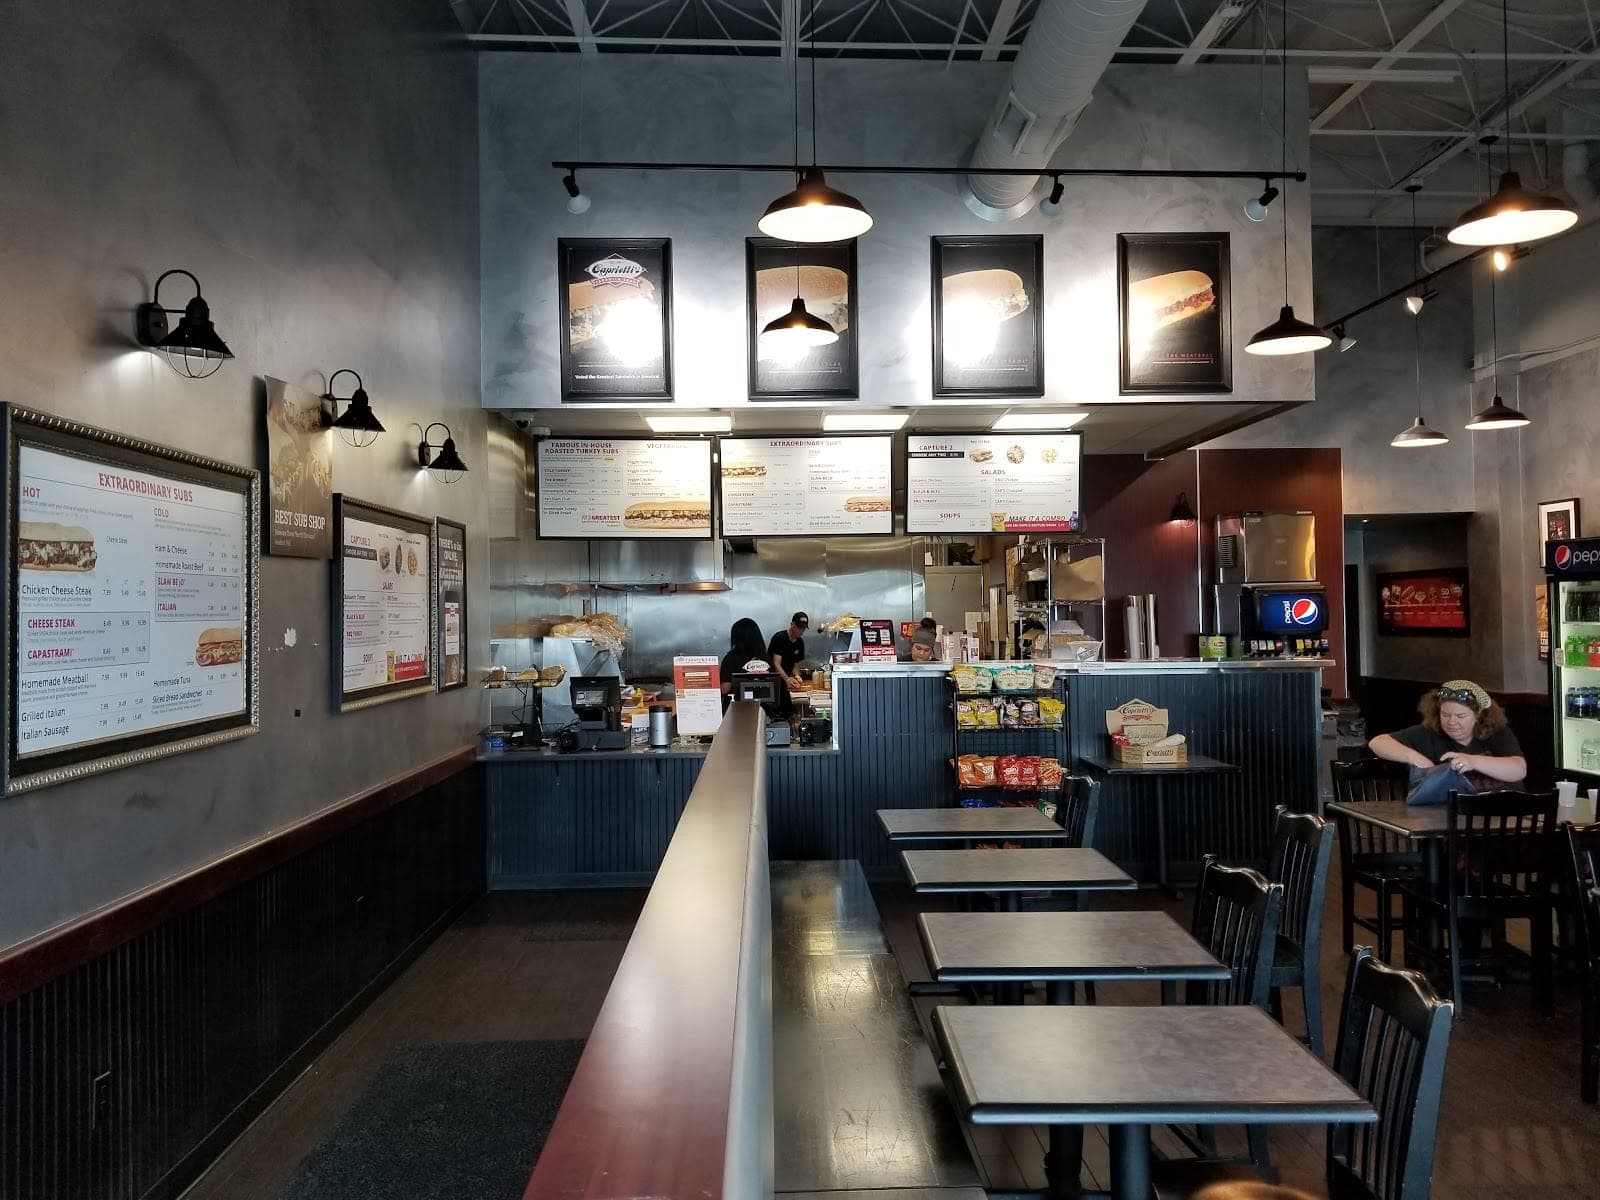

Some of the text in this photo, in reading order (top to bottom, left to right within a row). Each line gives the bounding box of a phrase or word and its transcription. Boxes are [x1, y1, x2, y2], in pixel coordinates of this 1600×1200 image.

[22, 486, 40, 499] HOT
[98, 472, 193, 502] EXTRAORDINARY SUBS
[154, 508, 169, 518] COLD
[274, 508, 326, 530] BEST SUB SHOP
[22, 584, 92, 596] Chicken Cheese Steak
[158, 602, 176, 612] ITALIAN
[1283, 600, 1292, 624] pepsi
[28, 618, 76, 628] CHEESE STEAK
[28, 648, 73, 660] CAPASTRAMI
[22, 673, 88, 688] Homemade Meatball
[22, 708, 66, 722] Grilled Italian
[22, 724, 70, 740] Italian Sausage
